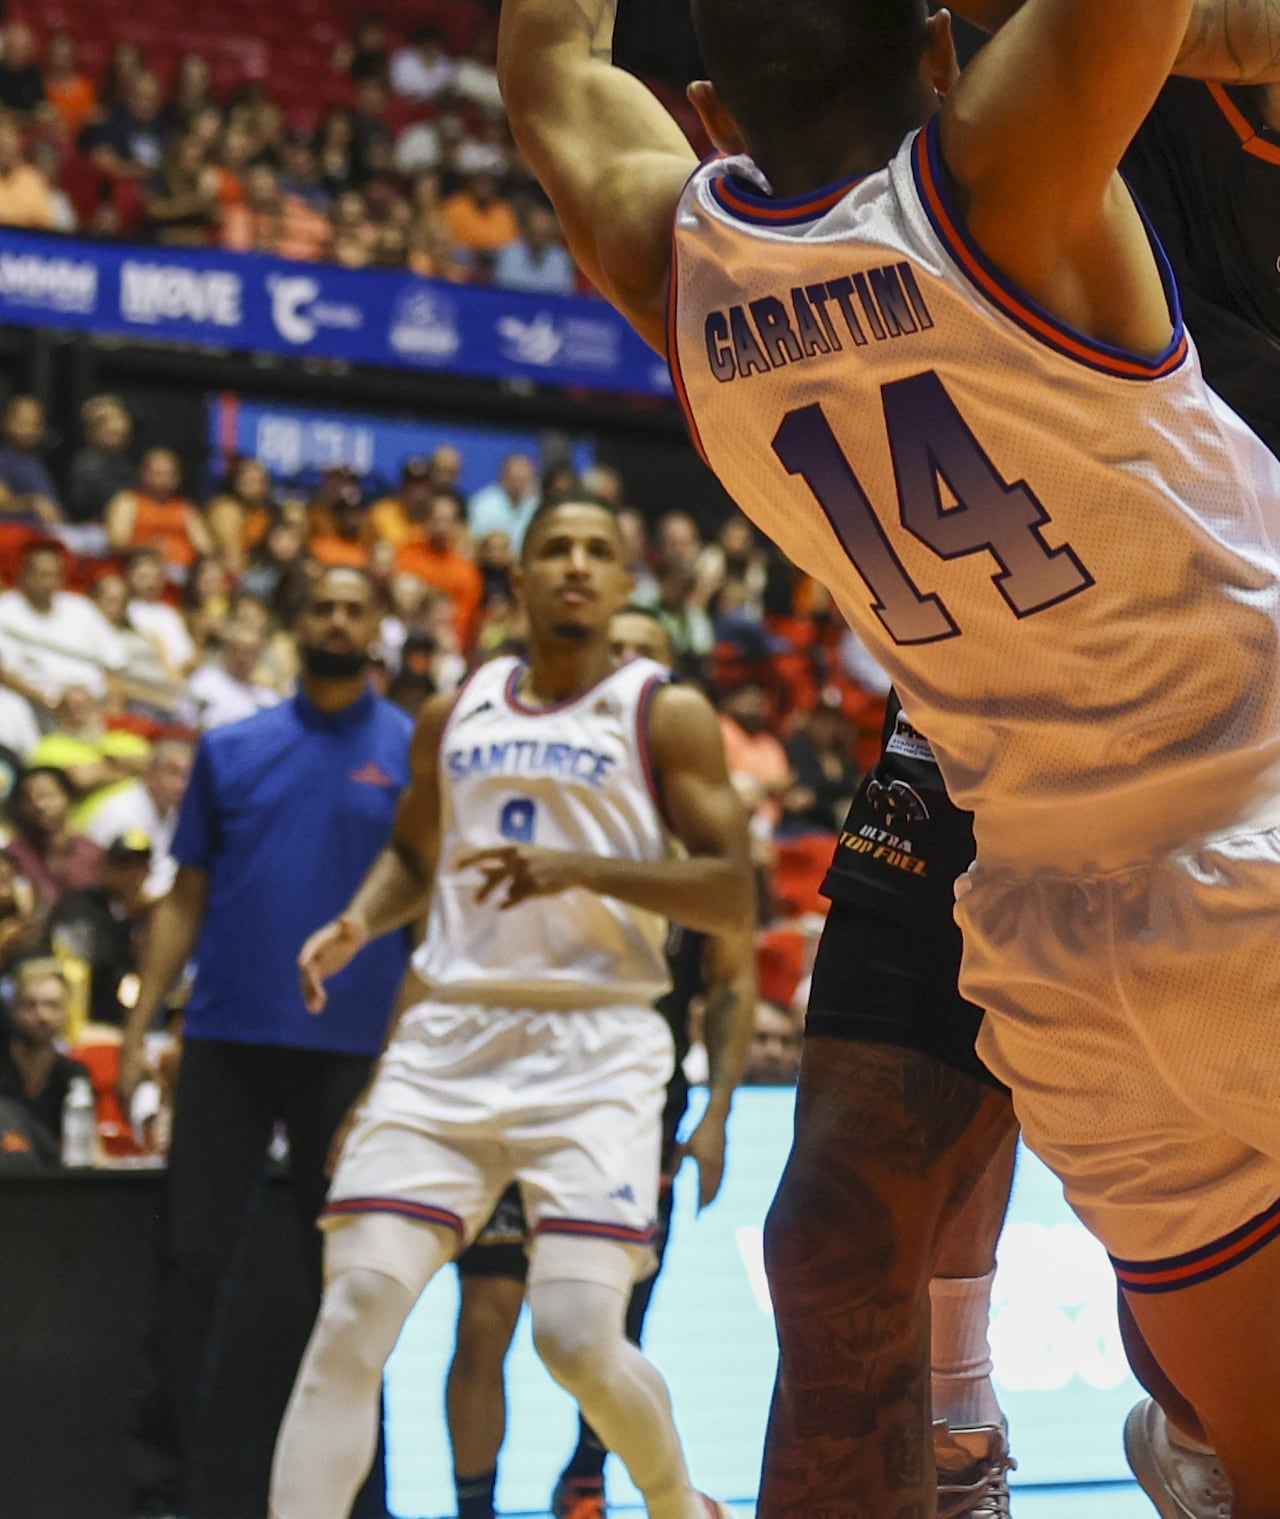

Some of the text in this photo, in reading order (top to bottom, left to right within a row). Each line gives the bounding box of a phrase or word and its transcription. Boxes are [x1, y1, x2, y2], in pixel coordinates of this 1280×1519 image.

[704, 261, 934, 383] CARATTINI
[770, 369, 1096, 646] 14
[448, 740, 615, 786] SANTURCE
[839, 830, 928, 877] TOP FUEL
[859, 824, 912, 854] ULTRA
